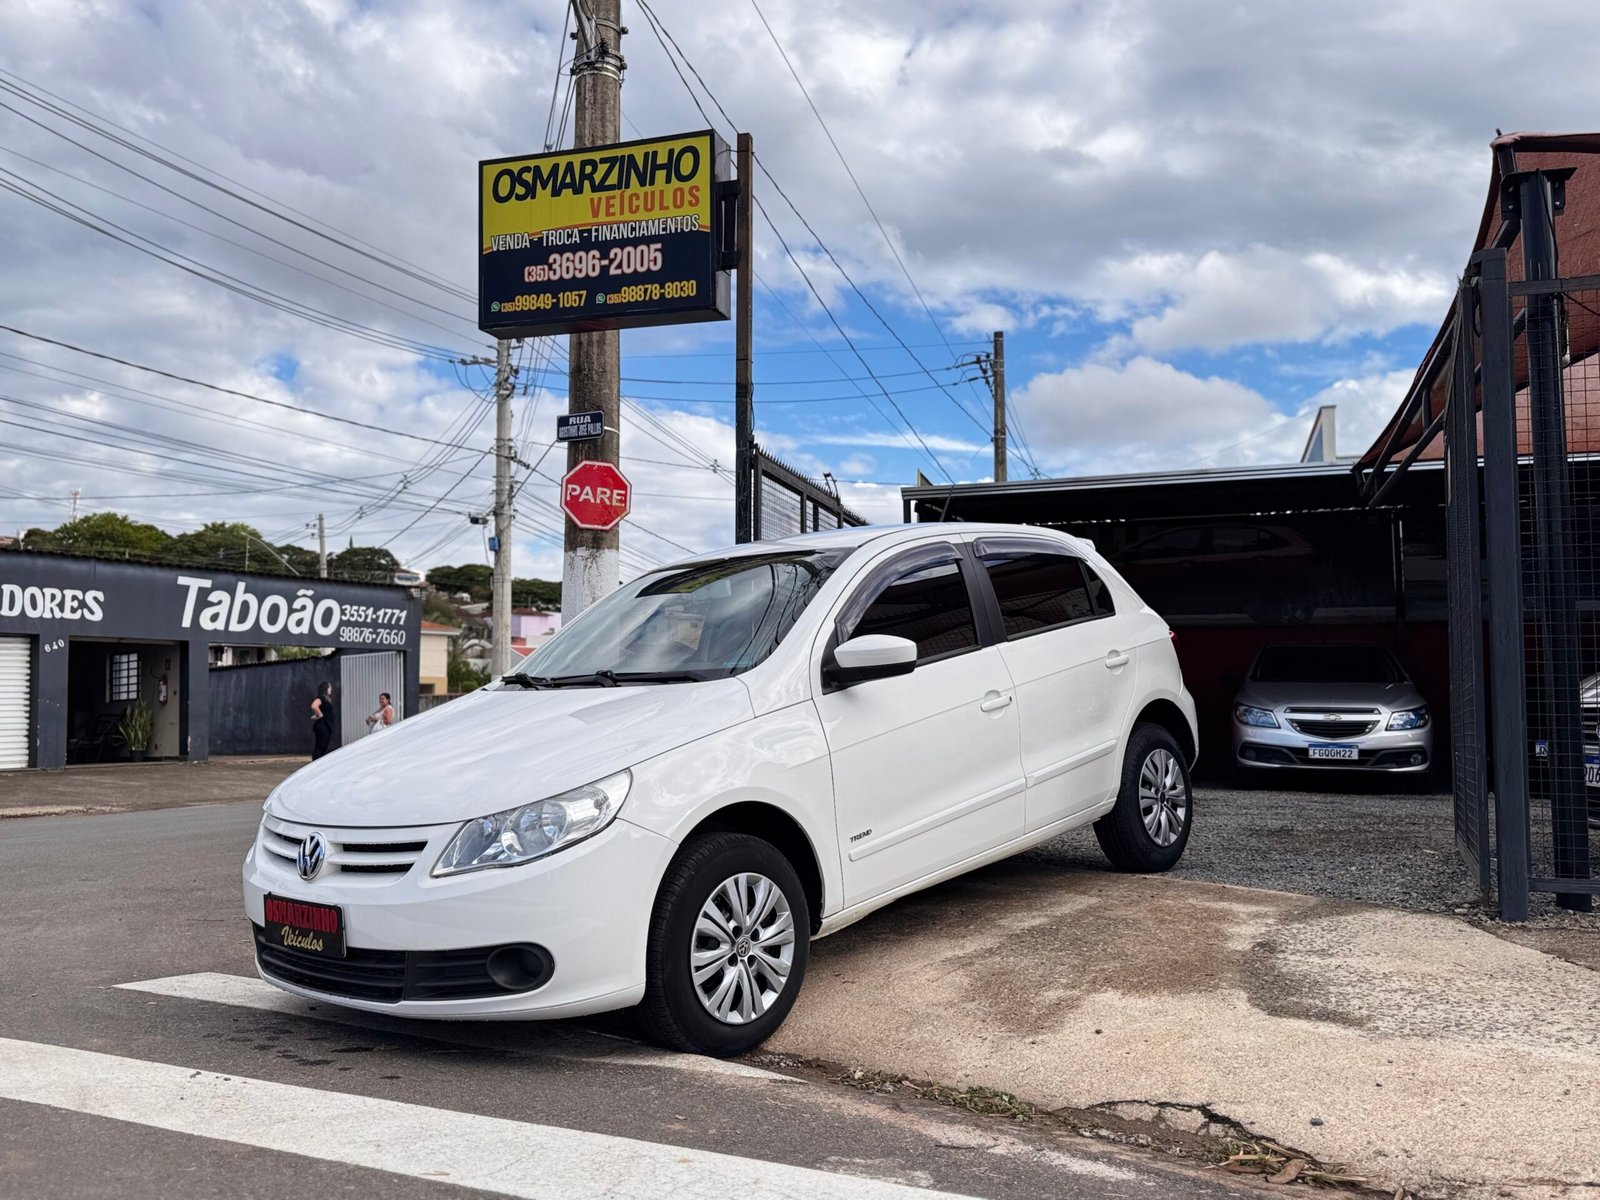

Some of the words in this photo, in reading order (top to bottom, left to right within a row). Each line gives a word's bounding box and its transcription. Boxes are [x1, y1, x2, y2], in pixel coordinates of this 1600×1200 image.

[492, 145, 700, 204] OSMARZINHO
[589, 185, 701, 219] VEÍCULOS
[491, 232, 531, 252] VENDA
[542, 228, 580, 247] TROCA
[591, 214, 700, 242] FINANCIAMENTOS
[569, 416, 591, 425] RUA
[566, 484, 626, 507] PARE
[0, 583, 105, 622] DORES
[176, 575, 341, 636] Taboão
[44, 639, 65, 653] 640
[849, 828, 873, 844] TREND
[266, 898, 338, 934] OSMARZINHO
